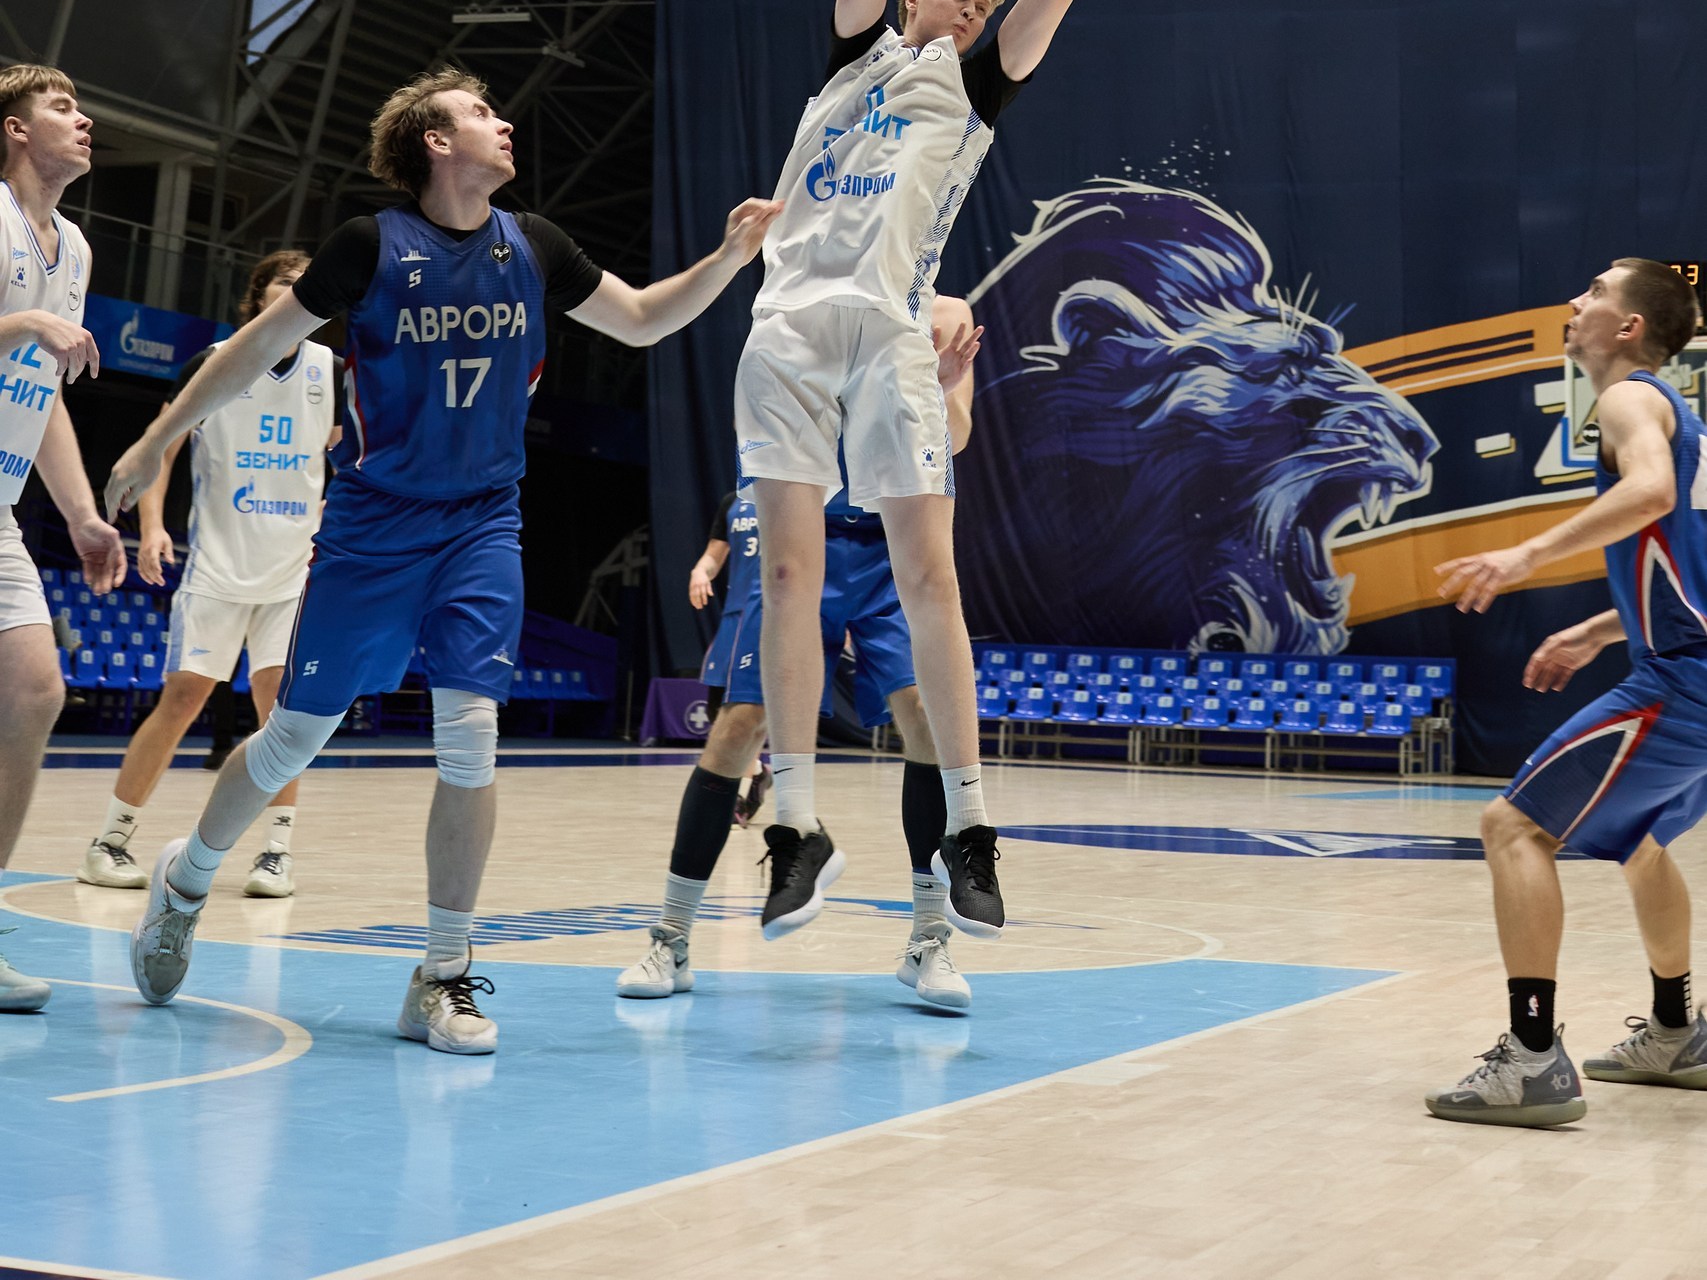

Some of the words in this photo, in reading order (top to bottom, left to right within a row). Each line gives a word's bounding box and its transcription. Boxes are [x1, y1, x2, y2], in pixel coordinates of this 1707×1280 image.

[837, 172, 896, 197] ЗПРОМ
[394, 301, 527, 345] АВРОРА
[0, 373, 55, 411] НИТ
[439, 357, 492, 408] 17
[259, 414, 292, 445] 50
[235, 451, 311, 470] ЗЕНИТ
[255, 499, 307, 516] ГАЗПРОМ
[730, 517, 759, 533] АВР
[743, 536, 759, 557] 3
